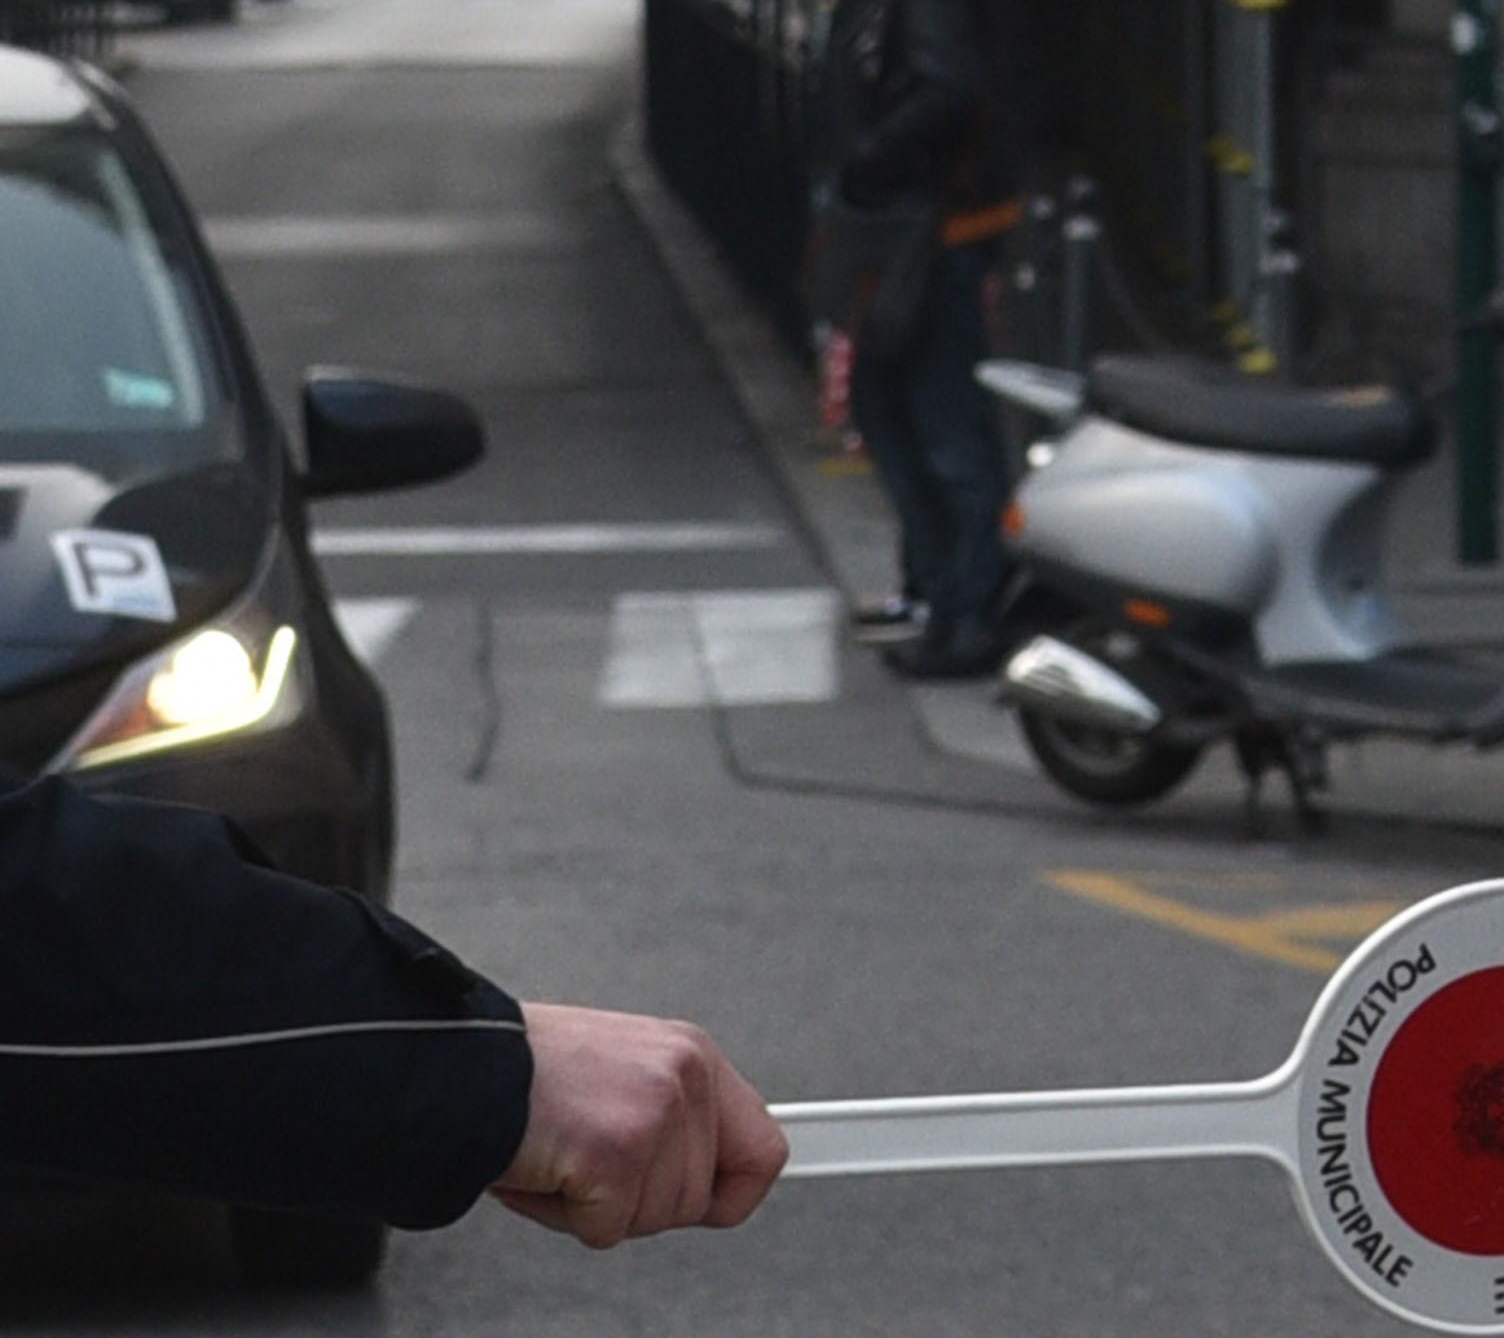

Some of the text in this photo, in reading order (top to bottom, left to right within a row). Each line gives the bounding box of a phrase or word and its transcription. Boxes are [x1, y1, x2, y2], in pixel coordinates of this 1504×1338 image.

[72, 541, 146, 600] P
[1315, 942, 1437, 1289] POLIZIA MUNICIPALE
